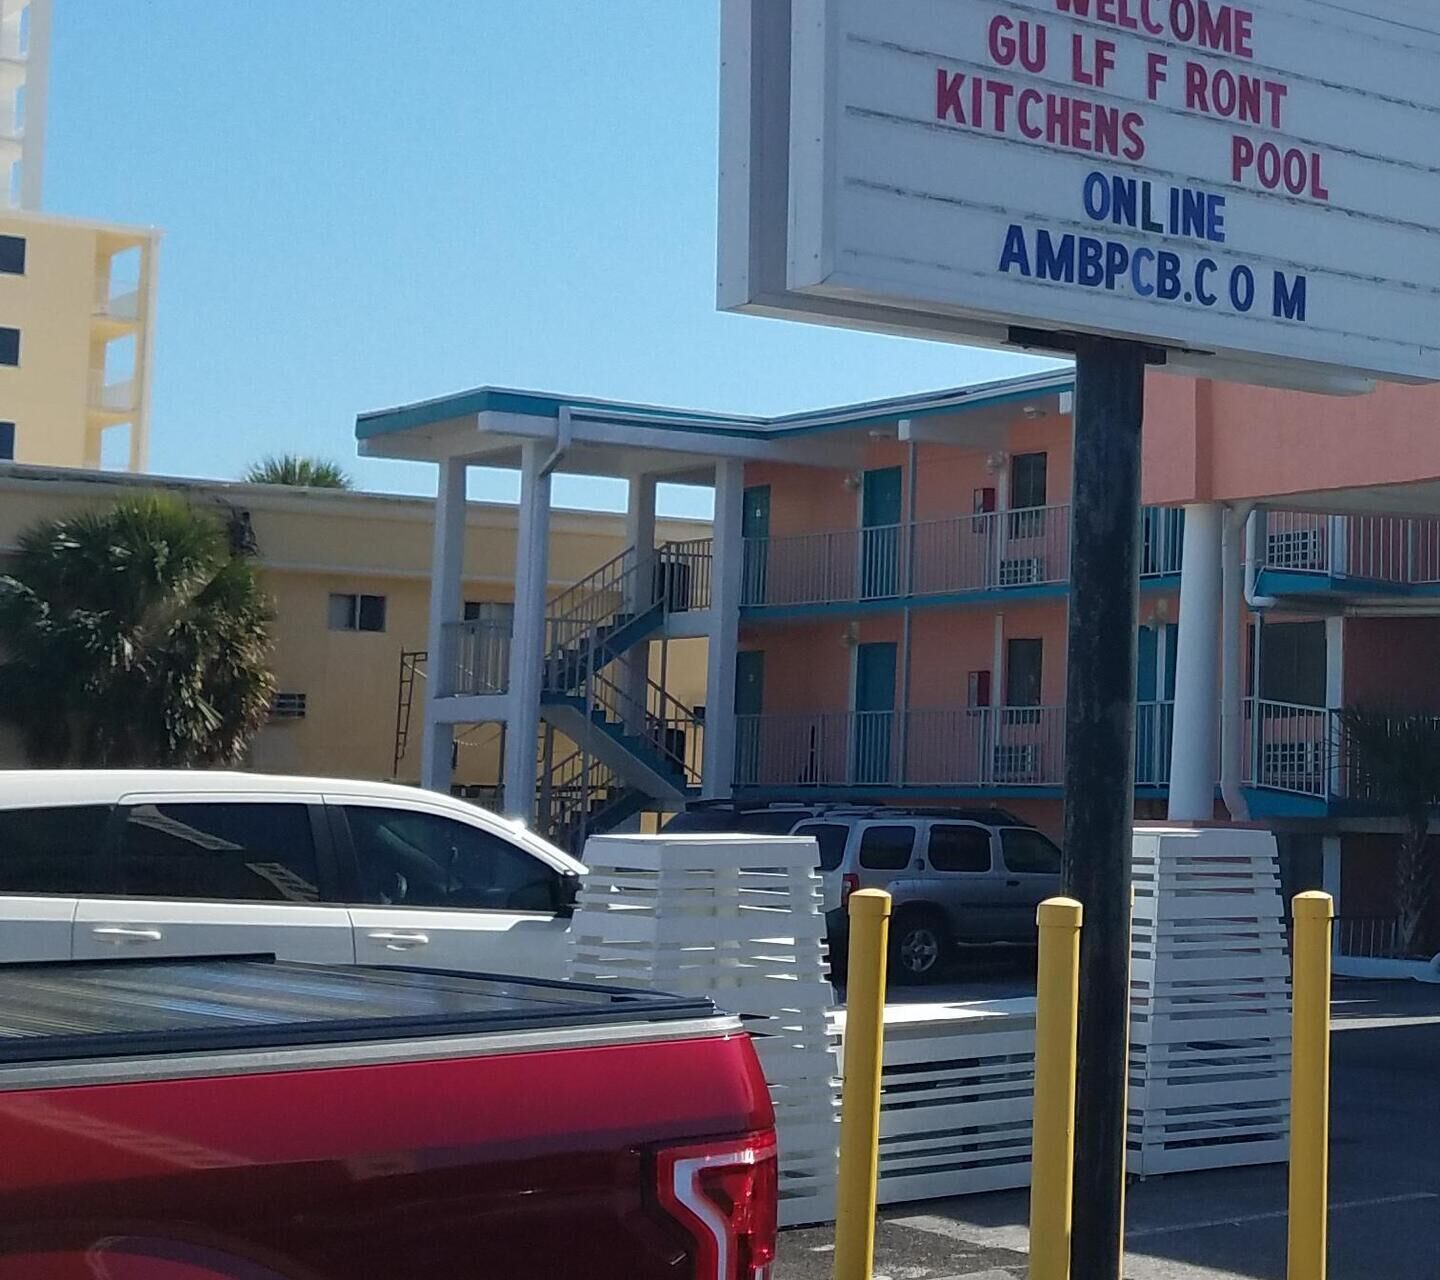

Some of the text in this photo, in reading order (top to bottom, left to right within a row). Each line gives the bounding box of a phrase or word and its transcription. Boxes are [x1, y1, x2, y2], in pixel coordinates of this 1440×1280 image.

[935, 68, 1330, 201] KITCHENS POOL
[1083, 171, 1227, 244] ONLINE
